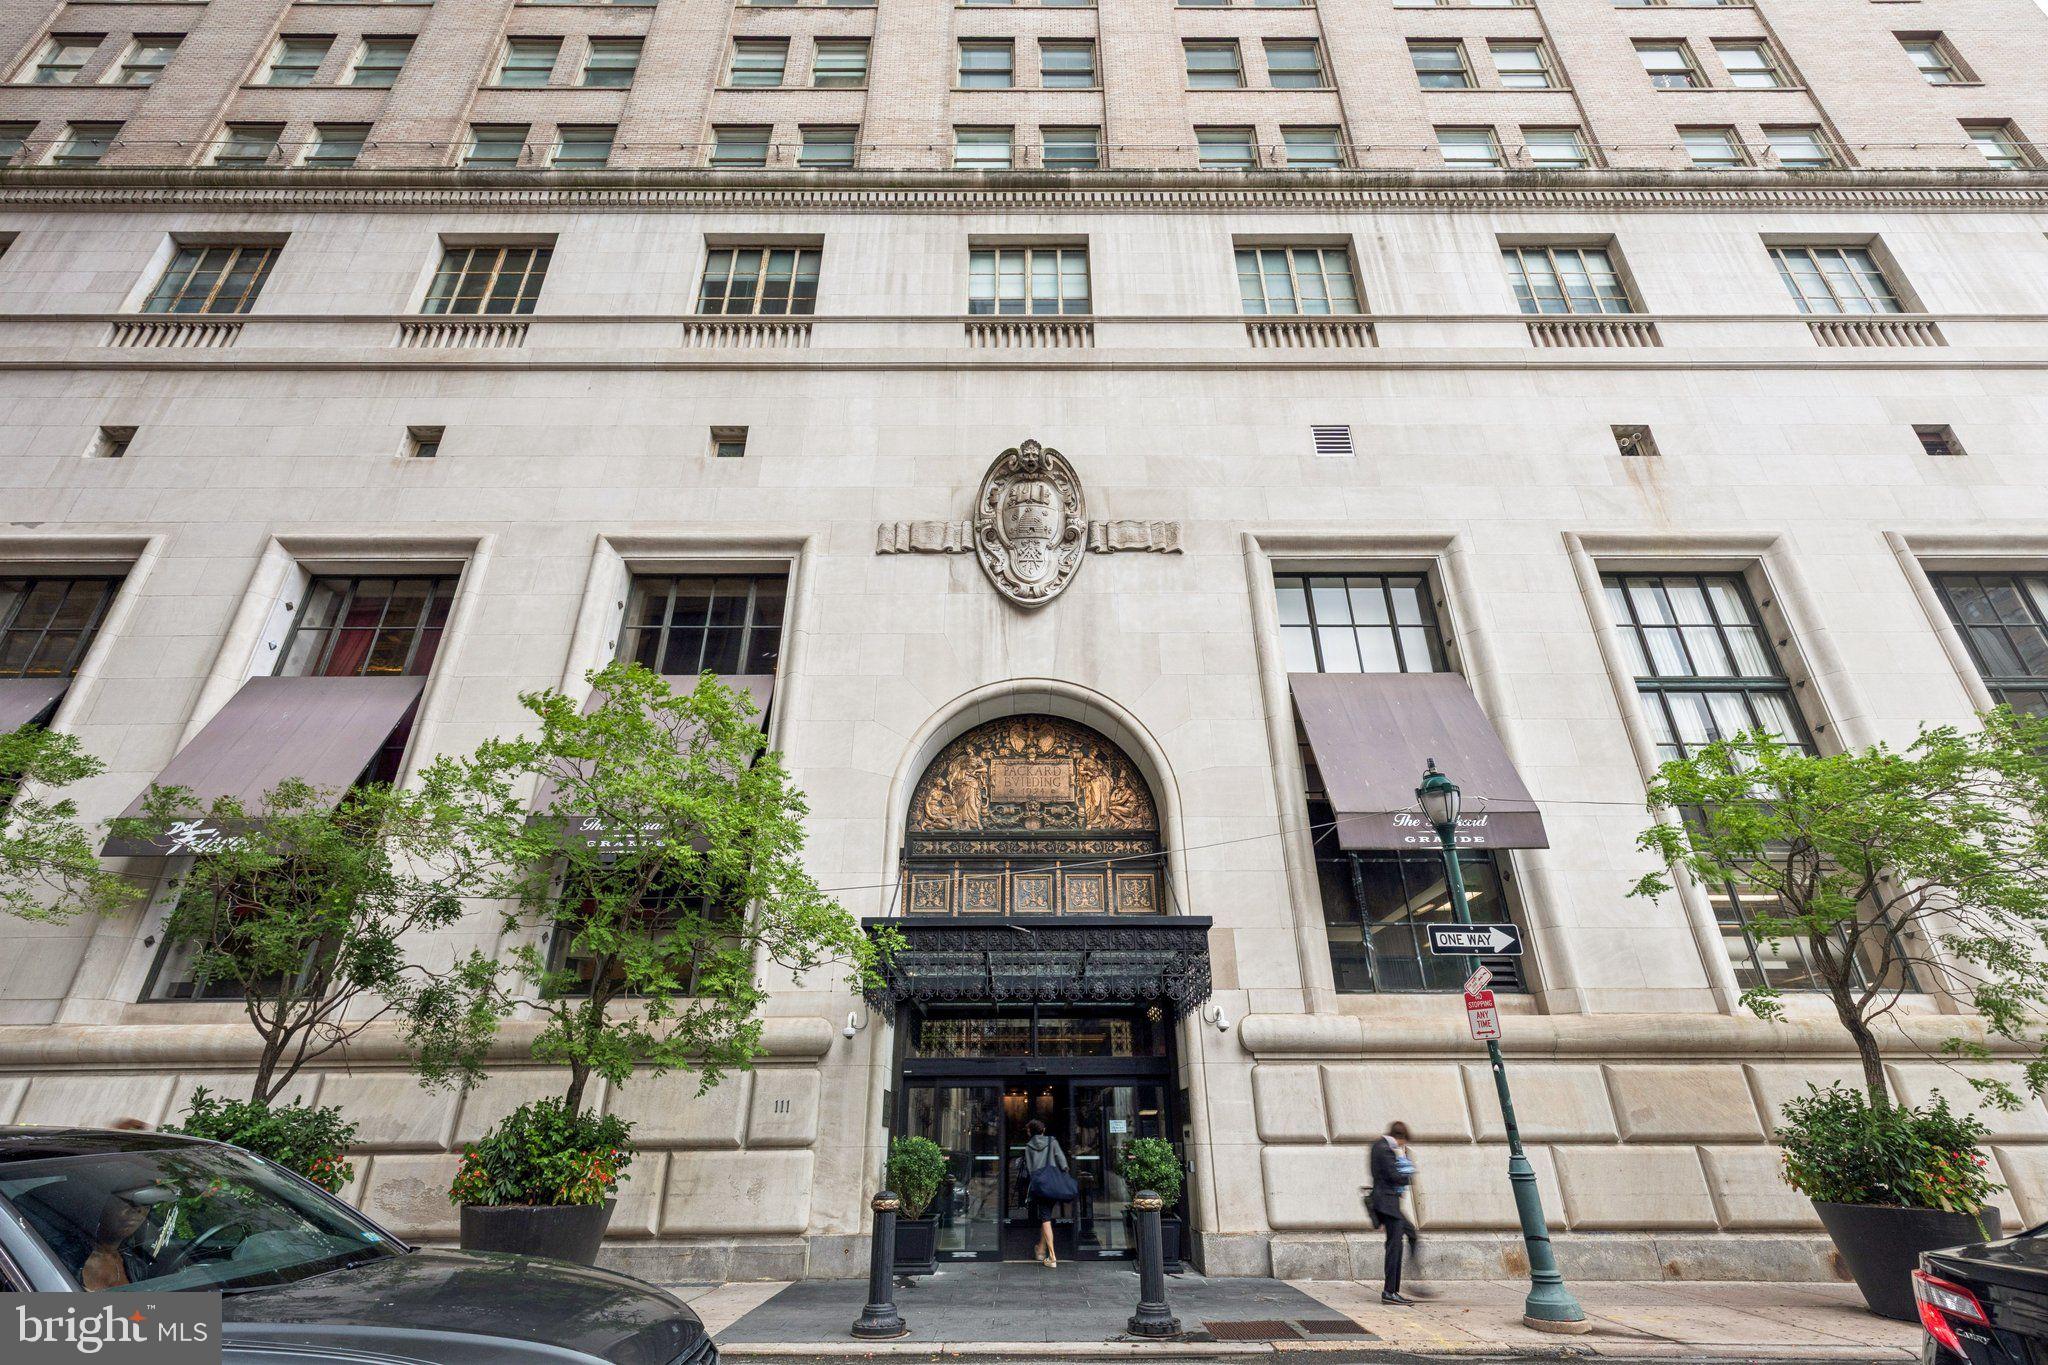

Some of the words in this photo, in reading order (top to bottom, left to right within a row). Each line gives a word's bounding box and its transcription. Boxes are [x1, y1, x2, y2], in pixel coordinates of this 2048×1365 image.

[1004, 766, 1062, 776] PACKARD
[1020, 788, 1045, 796] 1924
[580, 817, 608, 831] The
[1393, 813, 1420, 827] The
[165, 819, 204, 835] Del
[1440, 934, 1464, 945] ONE
[1467, 934, 1491, 946] WAY
[1468, 1000, 1493, 1009] STOPPING
[1476, 1011, 1489, 1019] ANY
[1477, 1020, 1492, 1028] TIME
